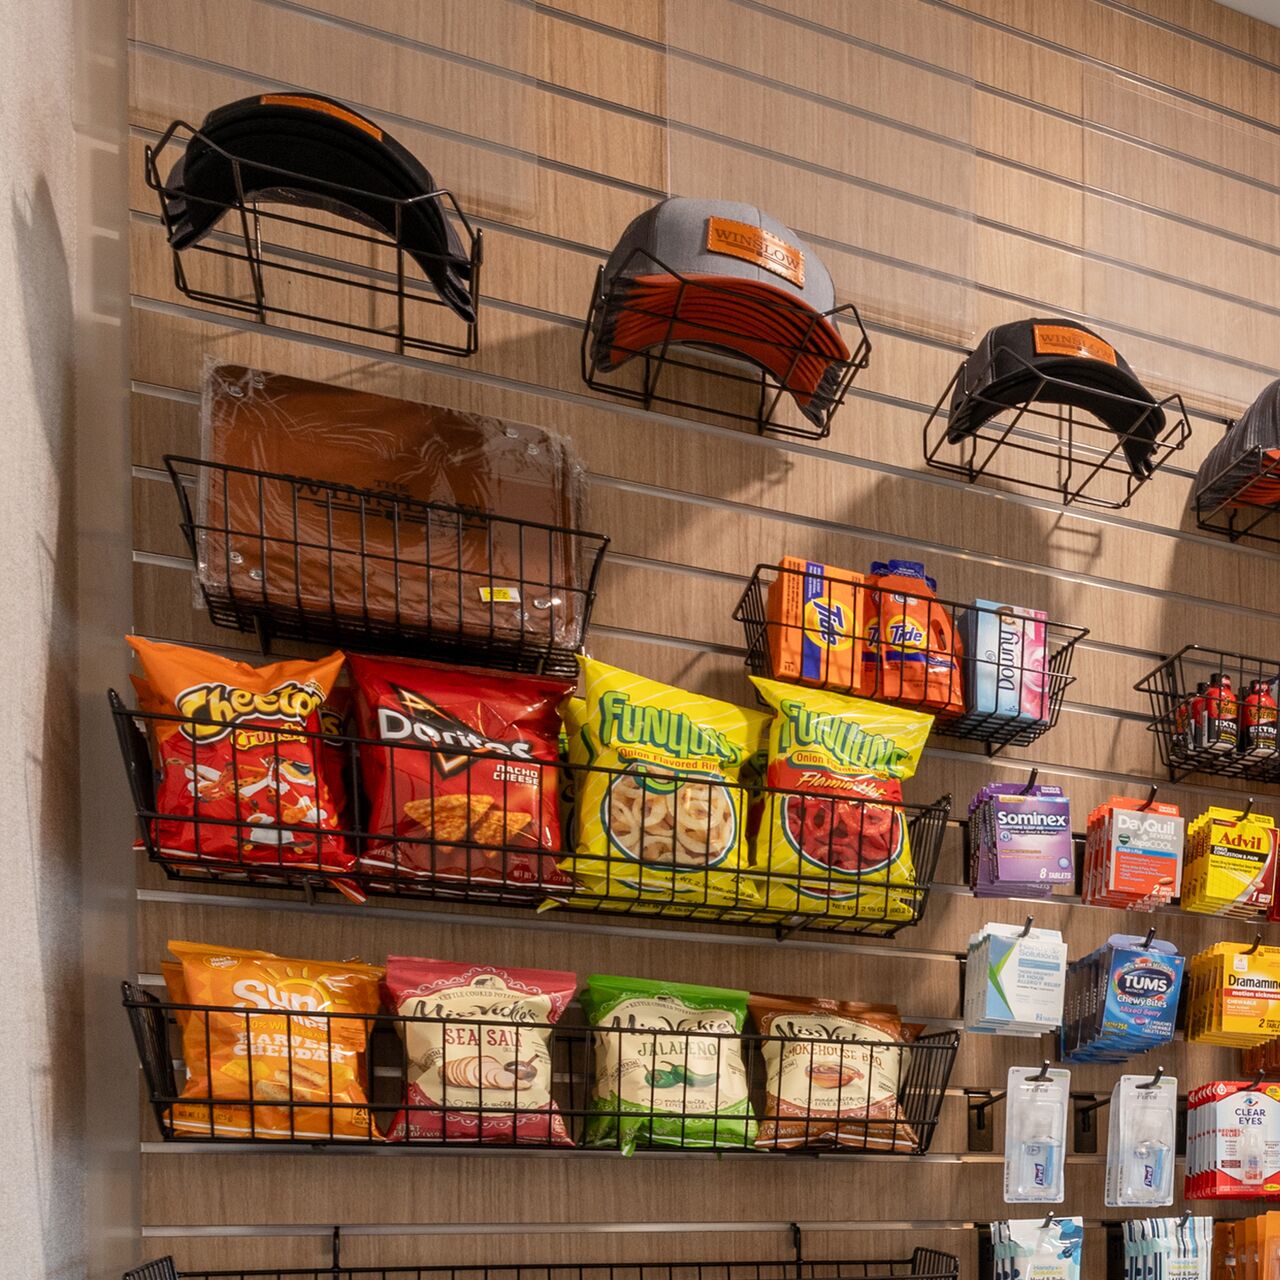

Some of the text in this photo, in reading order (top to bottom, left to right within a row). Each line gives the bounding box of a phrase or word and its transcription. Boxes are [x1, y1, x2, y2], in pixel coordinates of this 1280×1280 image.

[714, 228, 800, 270] WINSLOW
[812, 599, 845, 646] Tide
[889, 624, 923, 645] Tide
[998, 629, 1021, 692] Downy
[176, 681, 322, 744] Cheeto
[378, 708, 533, 758] Doritos
[619, 747, 698, 770] Onion Flavored
[796, 752, 825, 765] Onion
[493, 772, 540, 786] CHEESE
[496, 764, 539, 778] NACHO
[997, 811, 1067, 827] Sominex
[1117, 814, 1175, 834] DayQuil
[1218, 831, 1262, 850] Advil
[1040, 868, 1072, 879] 8 TABLETS
[1152, 884, 1160, 895] 2
[1124, 975, 1168, 993] TUMS
[233, 979, 329, 1021] Sun
[1117, 994, 1167, 1008] Chewy Bites
[1258, 1018, 1266, 1028] 2
[235, 1032, 345, 1052] HARVEST
[445, 1028, 479, 1046] SEA
[233, 1044, 345, 1064] CHEDDAR
[1235, 1108, 1266, 1117] CLEAR
[1238, 1117, 1263, 1125] EYES
